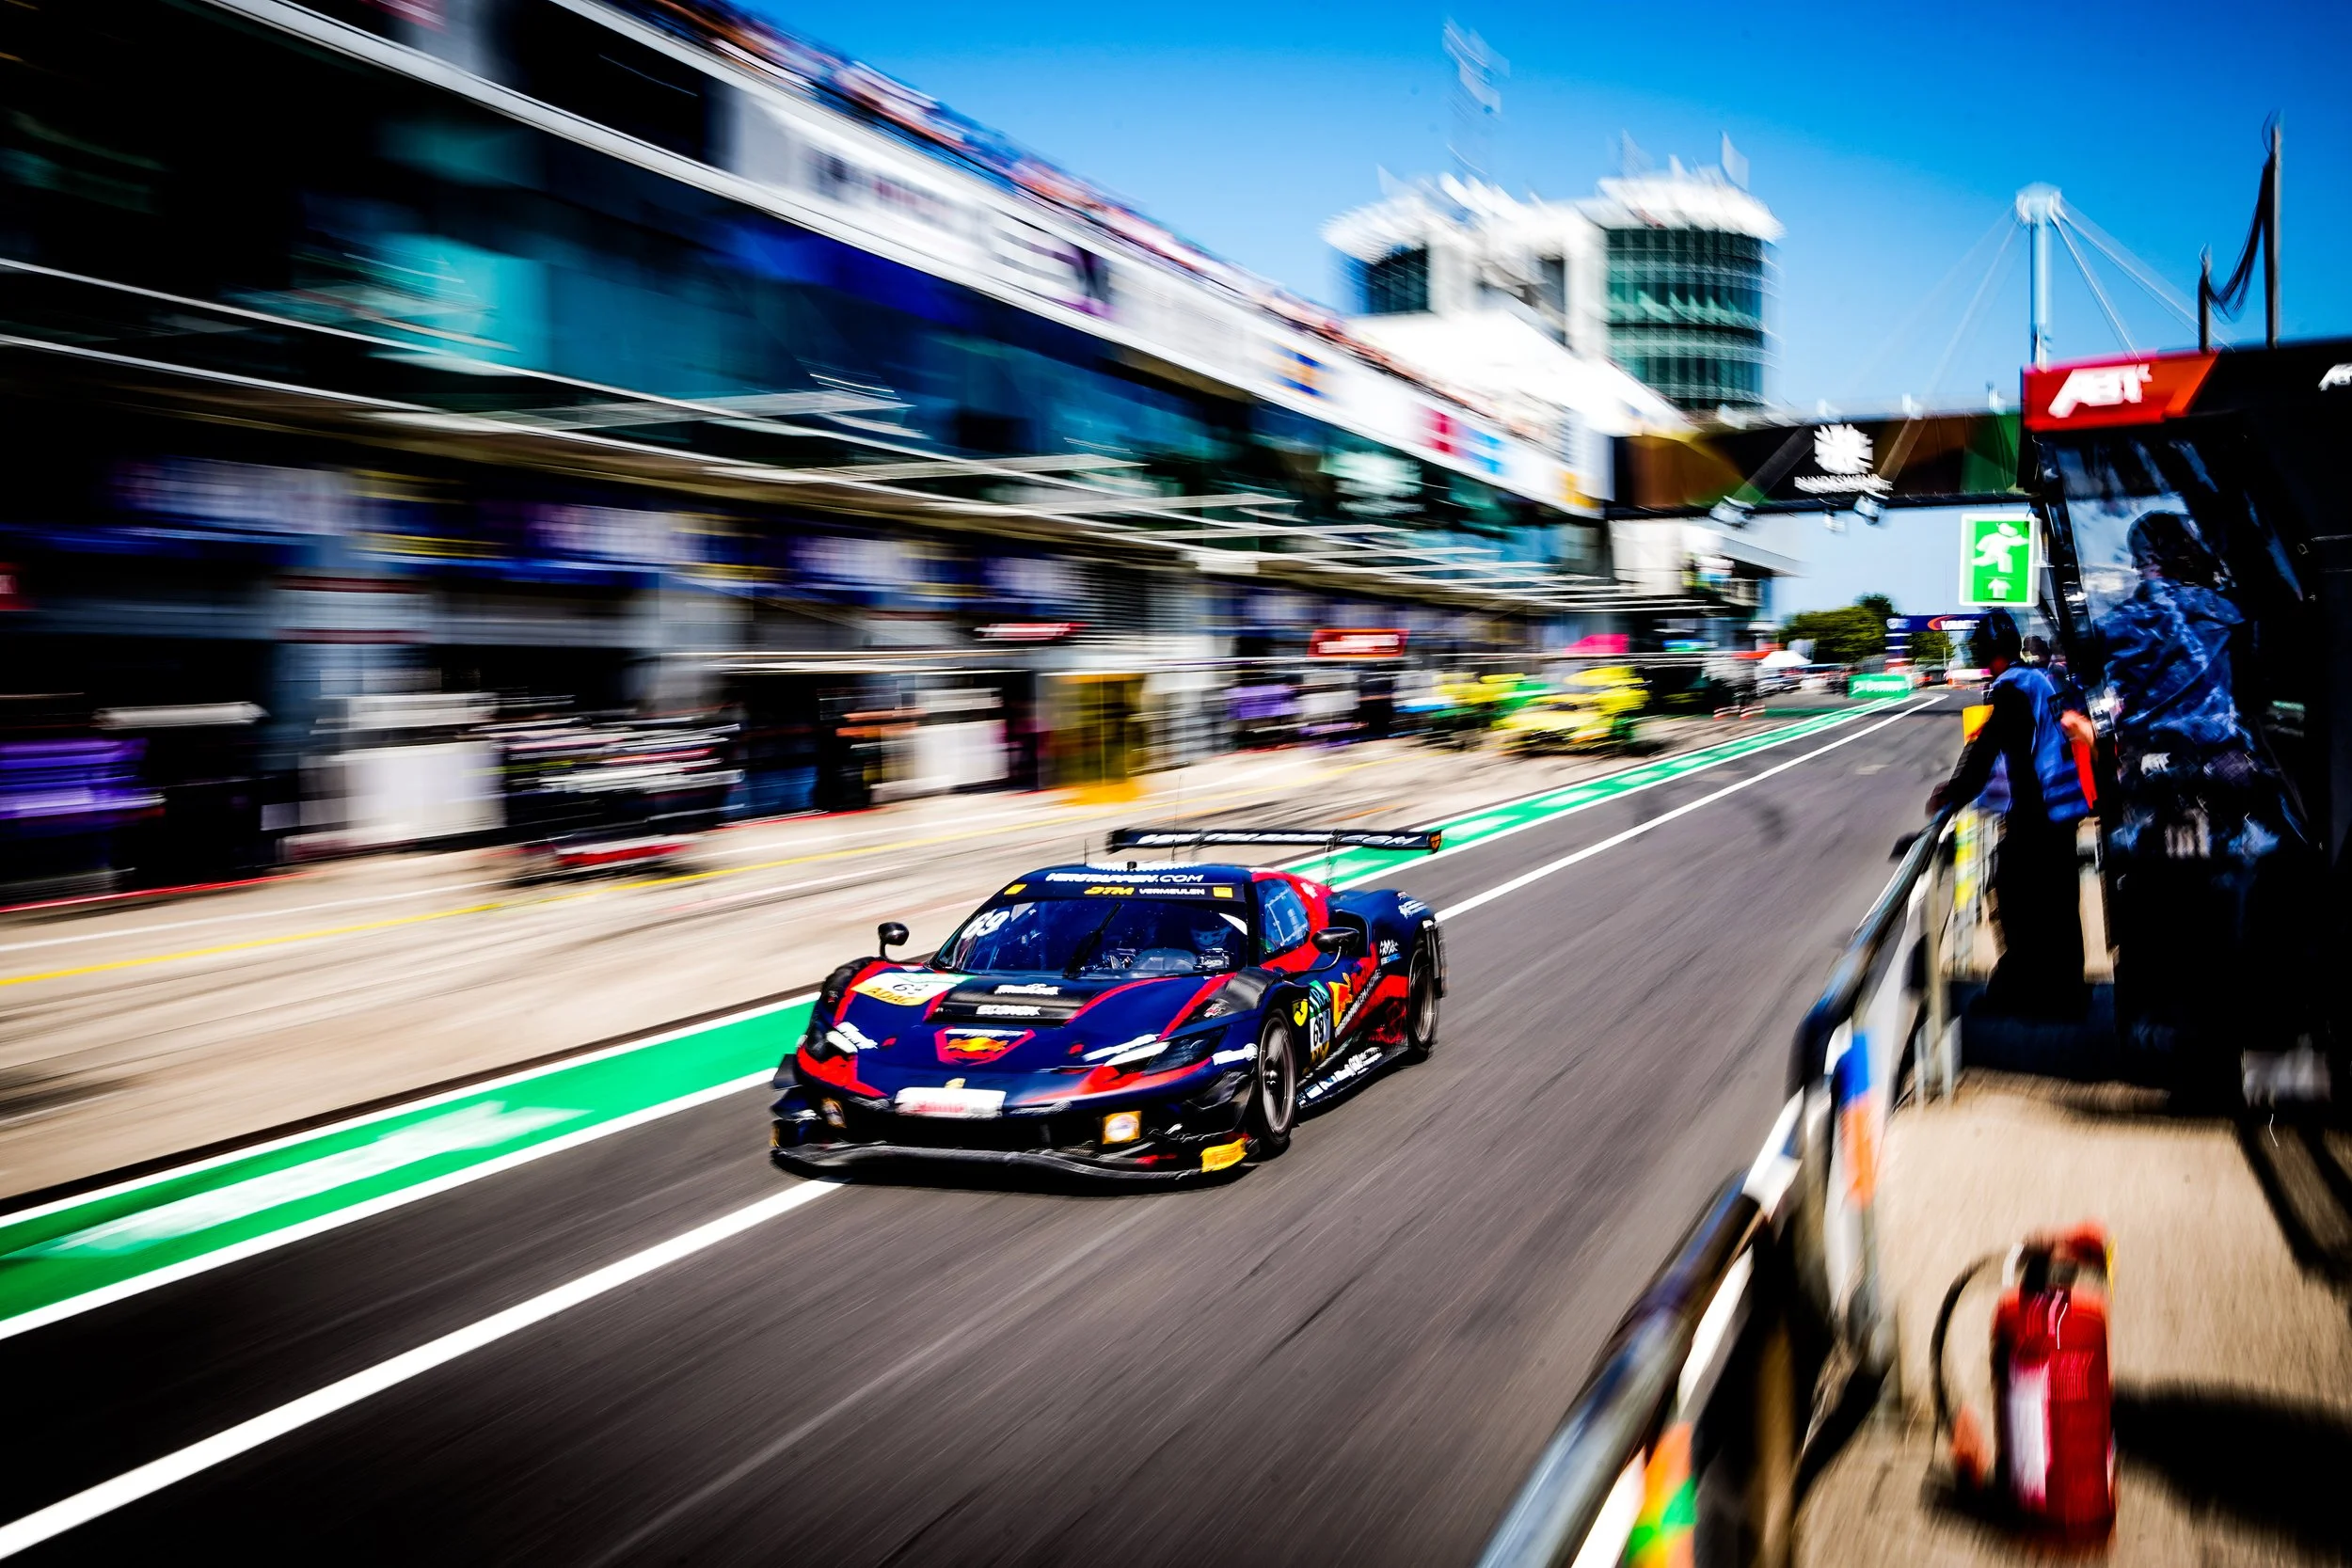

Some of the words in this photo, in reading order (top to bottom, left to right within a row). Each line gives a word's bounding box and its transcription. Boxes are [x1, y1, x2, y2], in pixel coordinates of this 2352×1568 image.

[2048, 363, 2153, 418] ABT
[1084, 886, 1135, 895] DTM
[961, 909, 1010, 940] 69
[1313, 1016, 1324, 1047] 69
